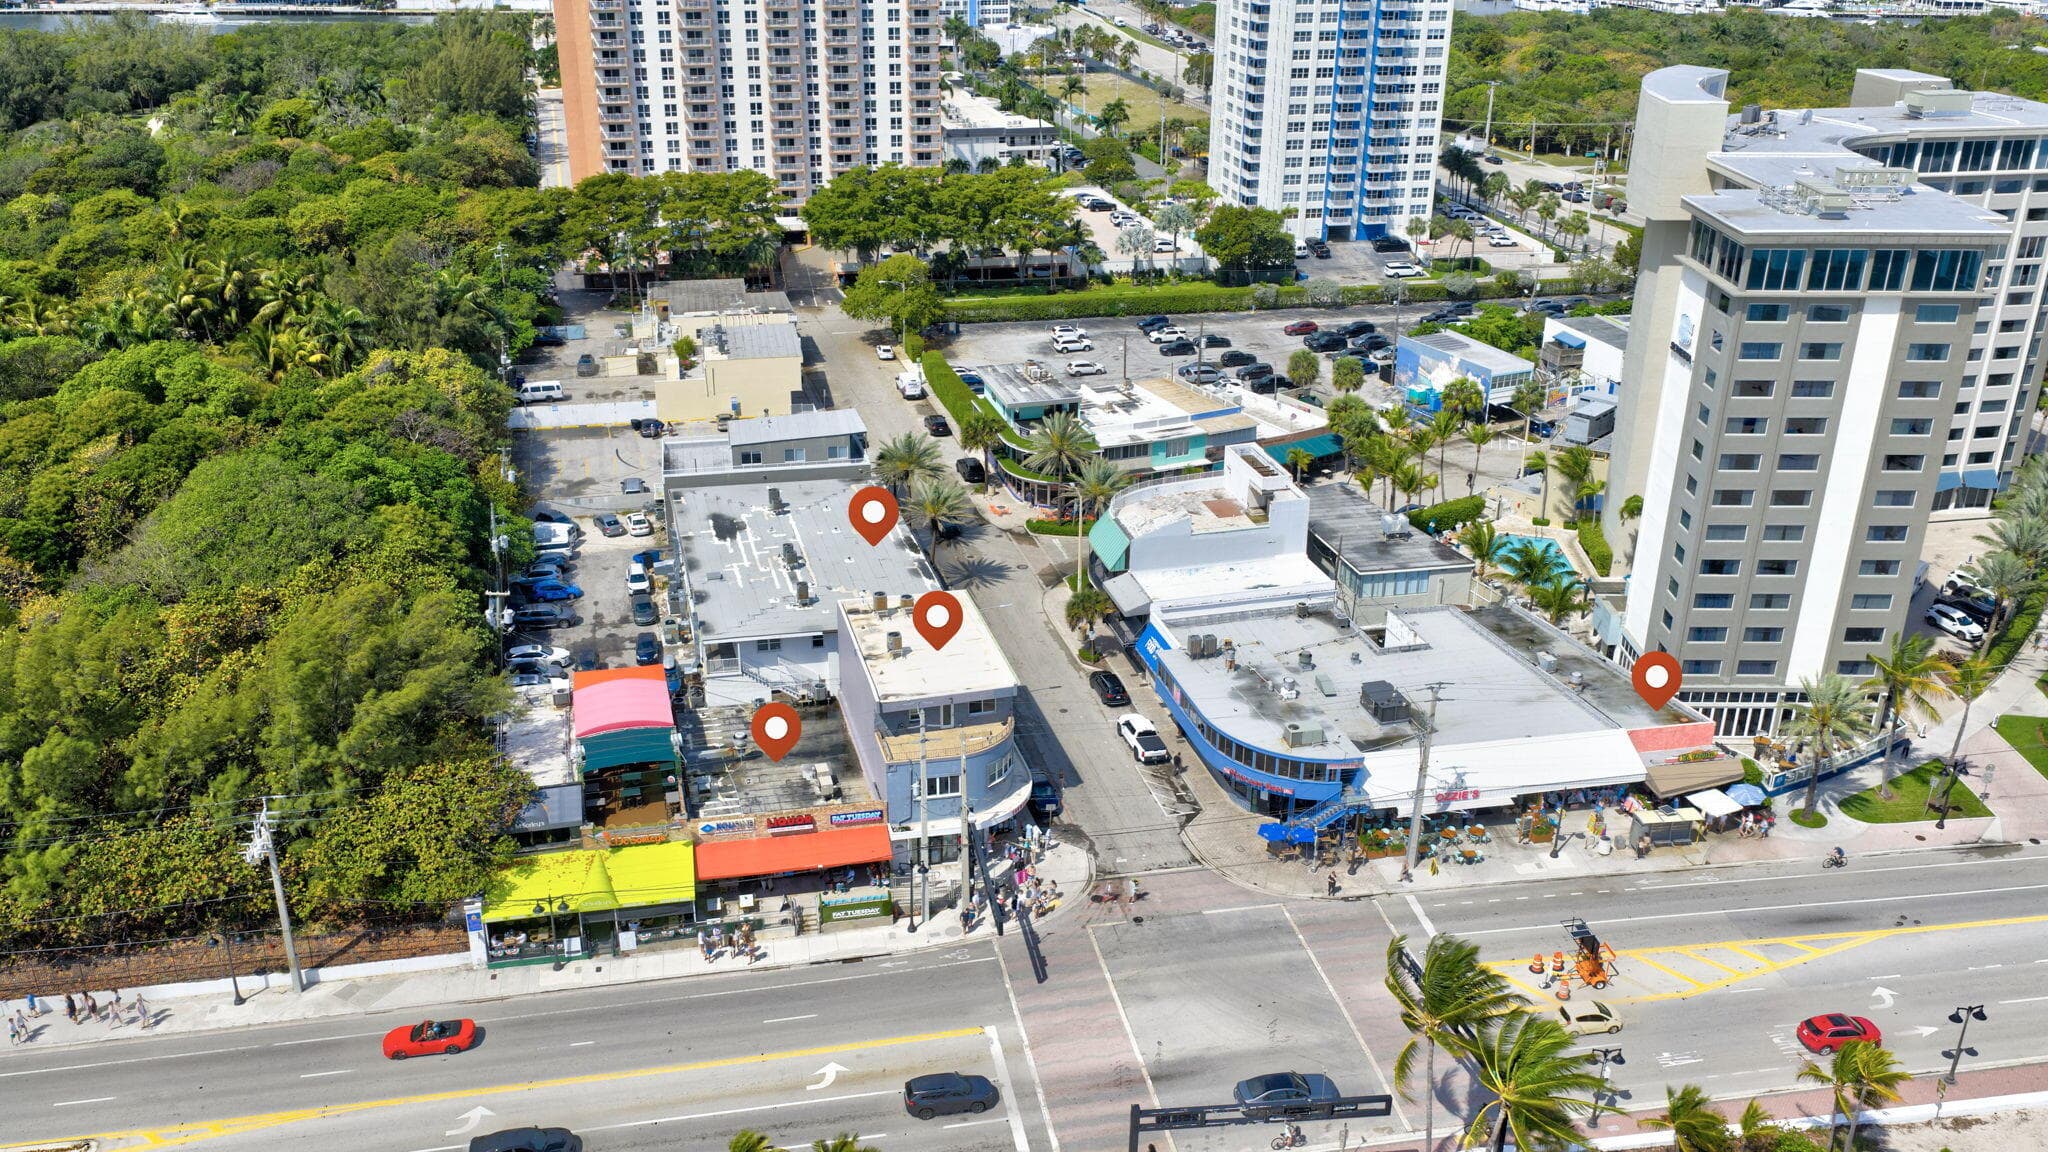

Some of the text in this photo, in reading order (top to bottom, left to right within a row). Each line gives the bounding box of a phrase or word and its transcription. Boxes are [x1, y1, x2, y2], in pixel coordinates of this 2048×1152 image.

[766, 814, 812, 829] LIQUOR
[831, 811, 881, 824] FAT TUESDAY
[832, 907, 880, 920] FAT TUESDAY
